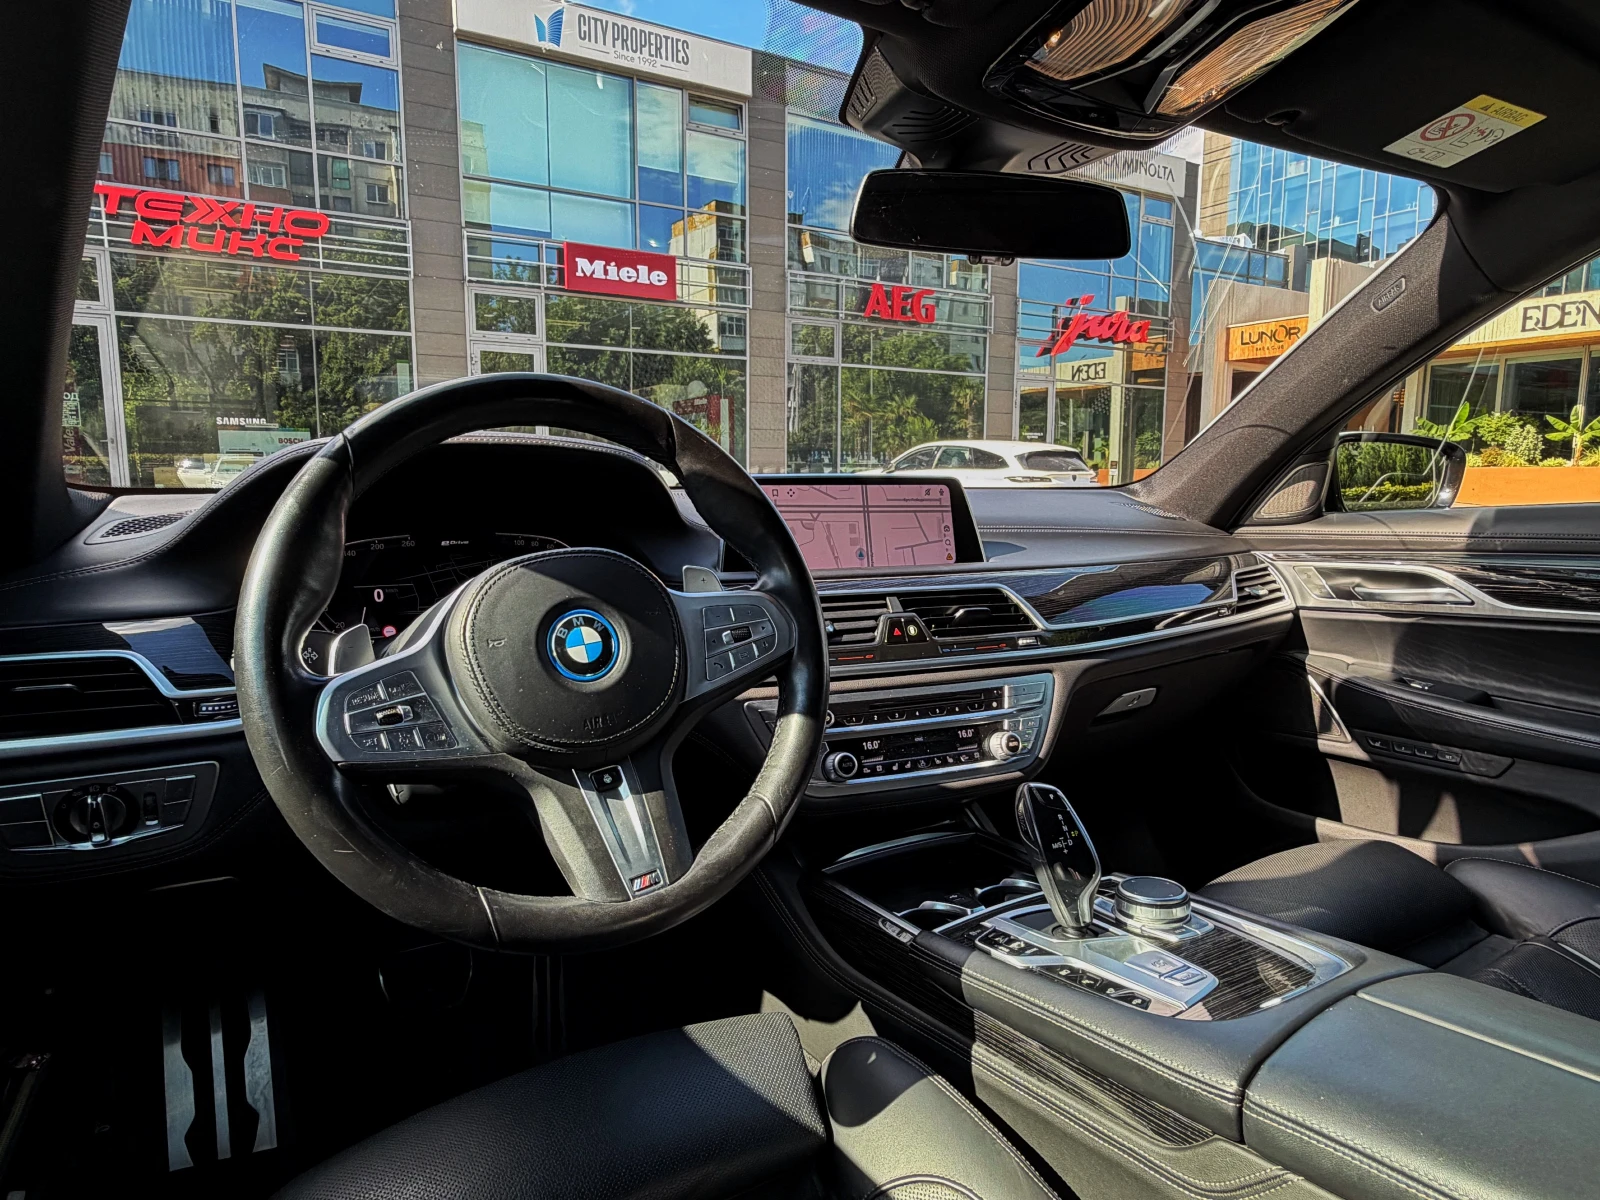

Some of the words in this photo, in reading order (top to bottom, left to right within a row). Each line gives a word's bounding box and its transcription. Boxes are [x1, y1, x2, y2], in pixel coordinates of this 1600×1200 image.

[577, 13, 609, 46] CITY
[611, 22, 690, 66] PROPERTIES
[613, 50, 635, 63] Since
[637, 56, 658, 68] 1992
[575, 257, 668, 286] Miele
[863, 282, 937, 324] AEG
[1520, 299, 1600, 332] EDEN
[1240, 324, 1301, 345] LUNOR
[216, 416, 267, 425] SAMSUNG
[277, 437, 304, 445] BOSCH
[373, 588, 384, 603] 0
[556, 616, 605, 639] BMW
